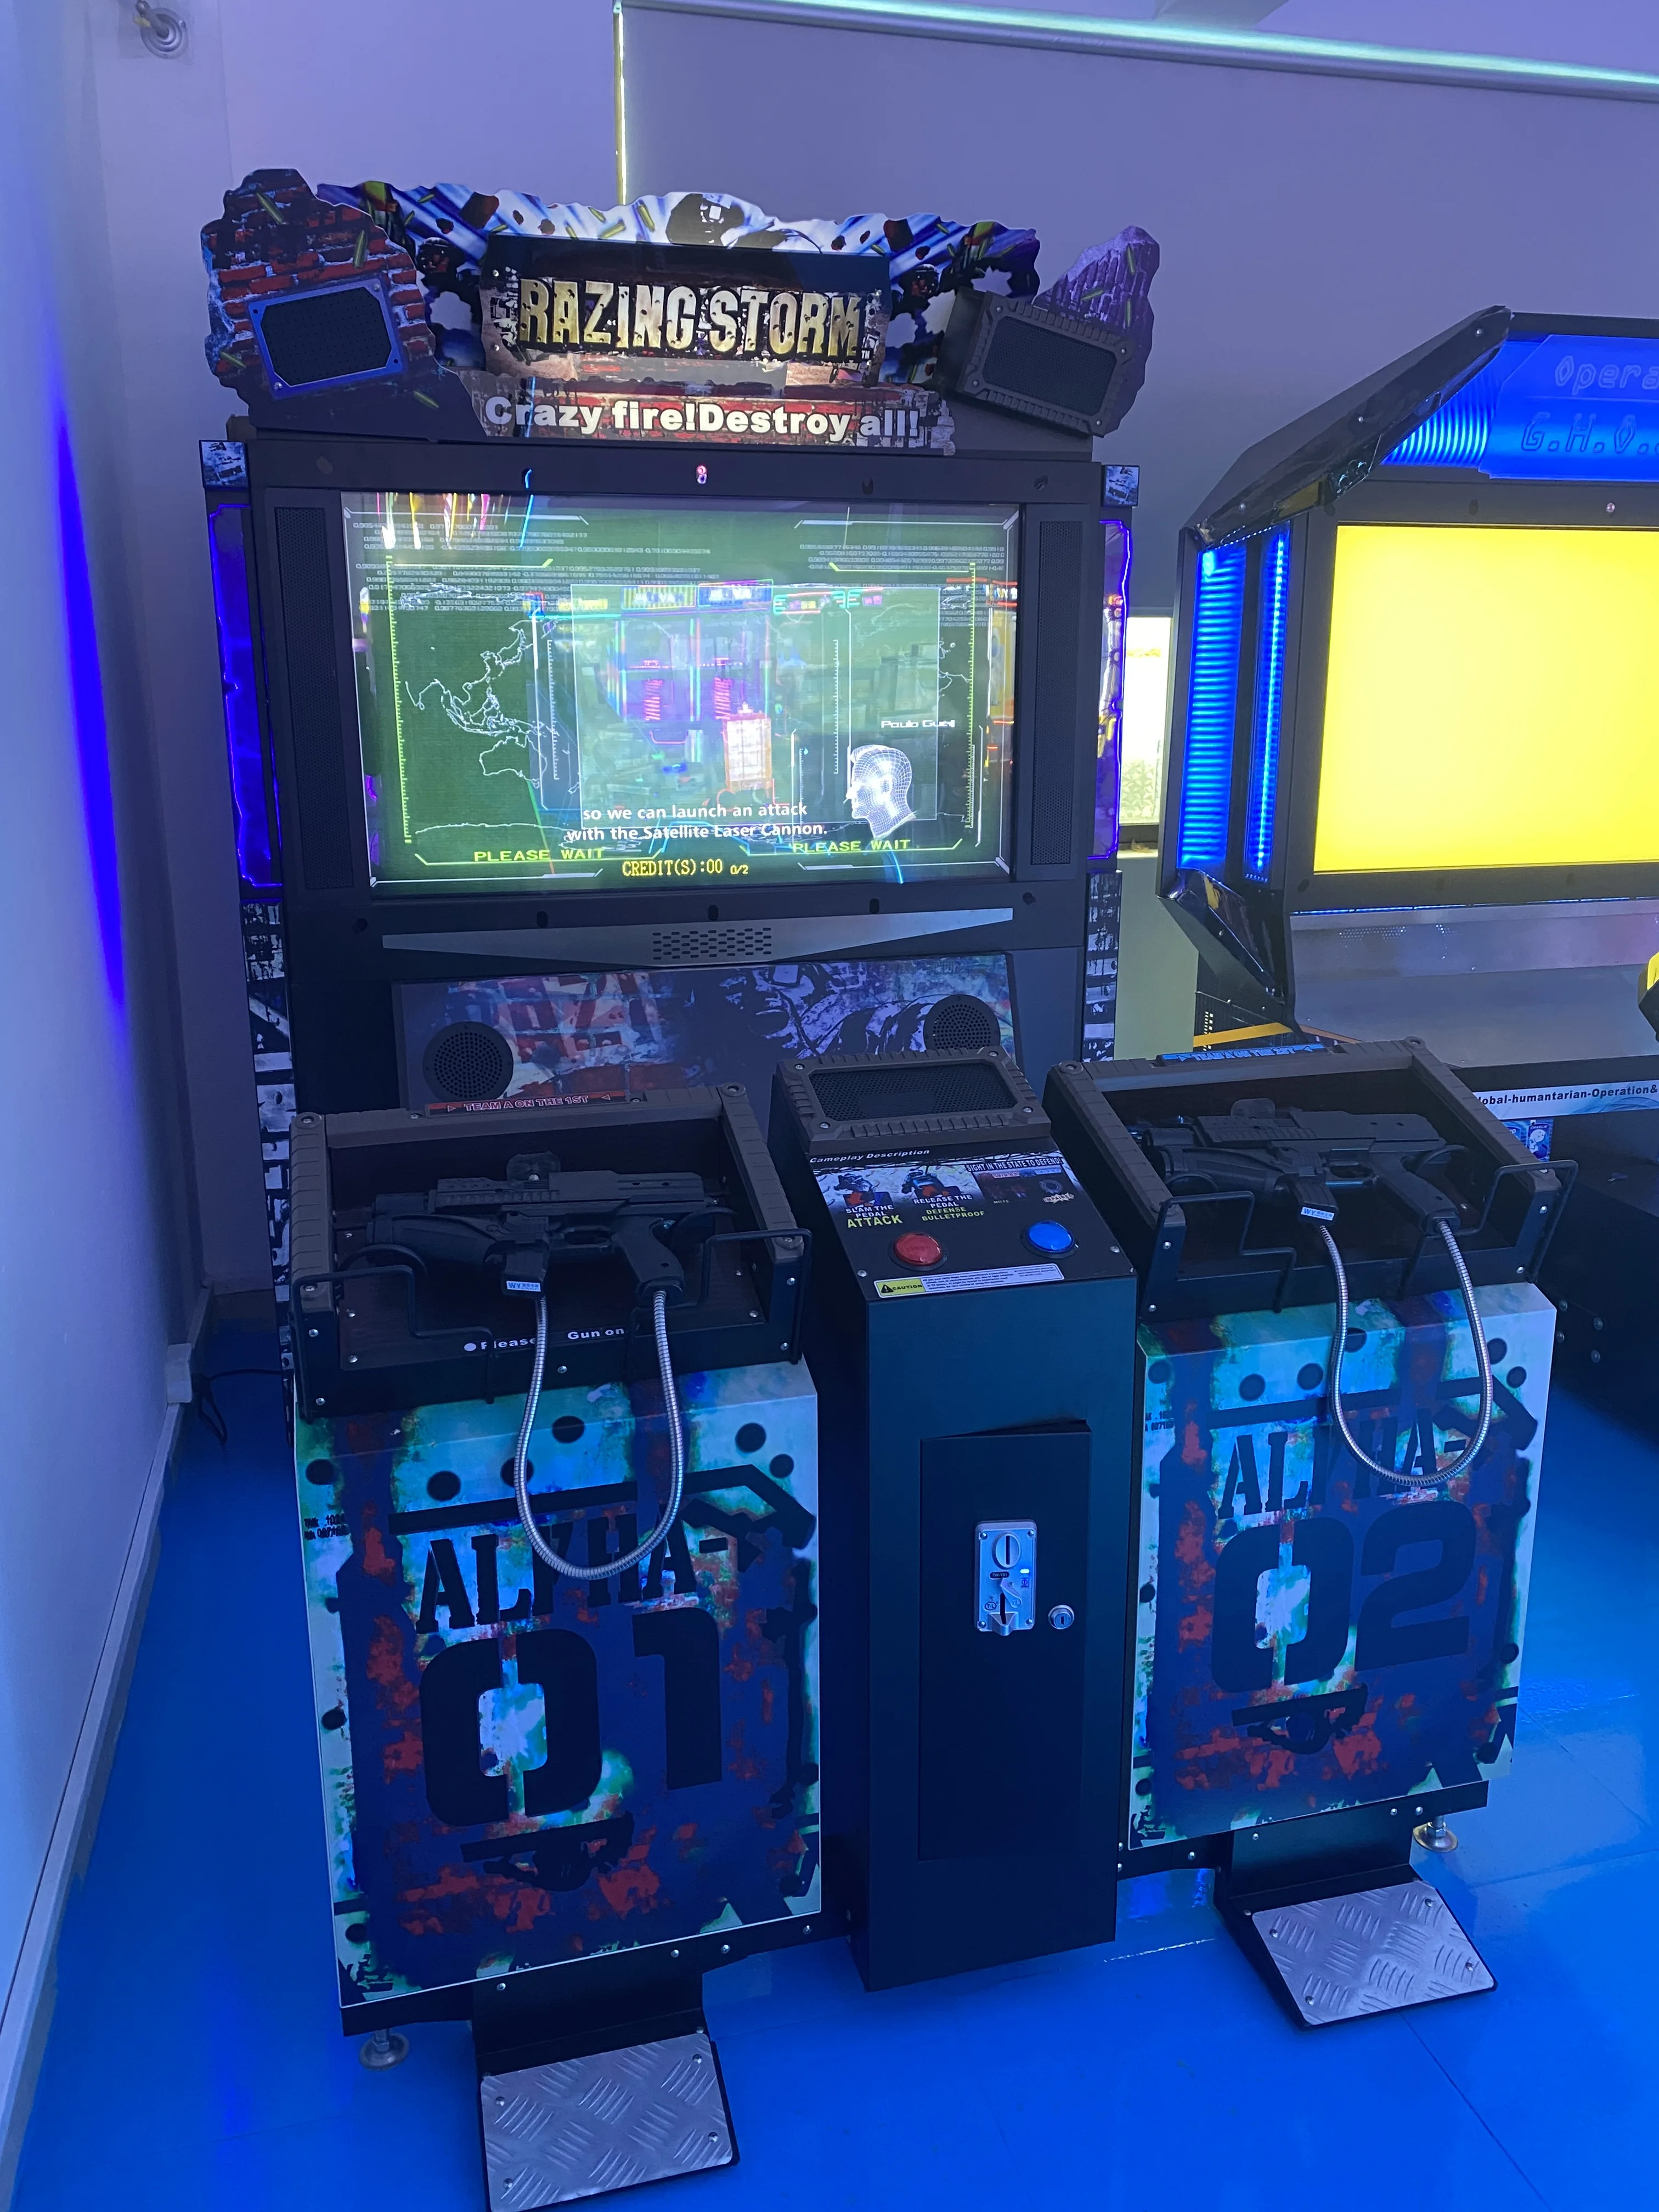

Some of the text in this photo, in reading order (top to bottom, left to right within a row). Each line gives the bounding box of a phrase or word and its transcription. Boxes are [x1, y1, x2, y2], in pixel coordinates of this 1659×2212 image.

[520, 279, 697, 349] RAZING
[709, 290, 862, 357] STORM
[486, 396, 603, 435] Crazy
[859, 409, 919, 437] all!
[1521, 412, 1659, 455] G.H.O.
[583, 802, 808, 820] so we can launch an attack
[567, 823, 827, 841] with the Satellite Laser Cannon.
[792, 839, 911, 854] PLEASE WAIT
[474, 848, 605, 862] PLEASE WAIT
[464, 1094, 589, 1111] TEAM A ON THE 1ST
[866, 1150, 930, 1159] Description
[966, 1163, 986, 1172] SIGHT
[996, 1161, 1008, 1170] THE
[1008, 1160, 1028, 1169] STATE
[1035, 1157, 1063, 1165] DEFEND!
[913, 1196, 955, 1205] RELEASE
[921, 1210, 985, 1222] BULLETPROOF
[926, 1206, 966, 1215] DEFENSE
[848, 1214, 904, 1228] ATTACK
[567, 1330, 601, 1340] Gun
[605, 1327, 625, 1336] on
[1211, 1500, 1477, 1693] 02
[419, 1607, 723, 1826] 01
